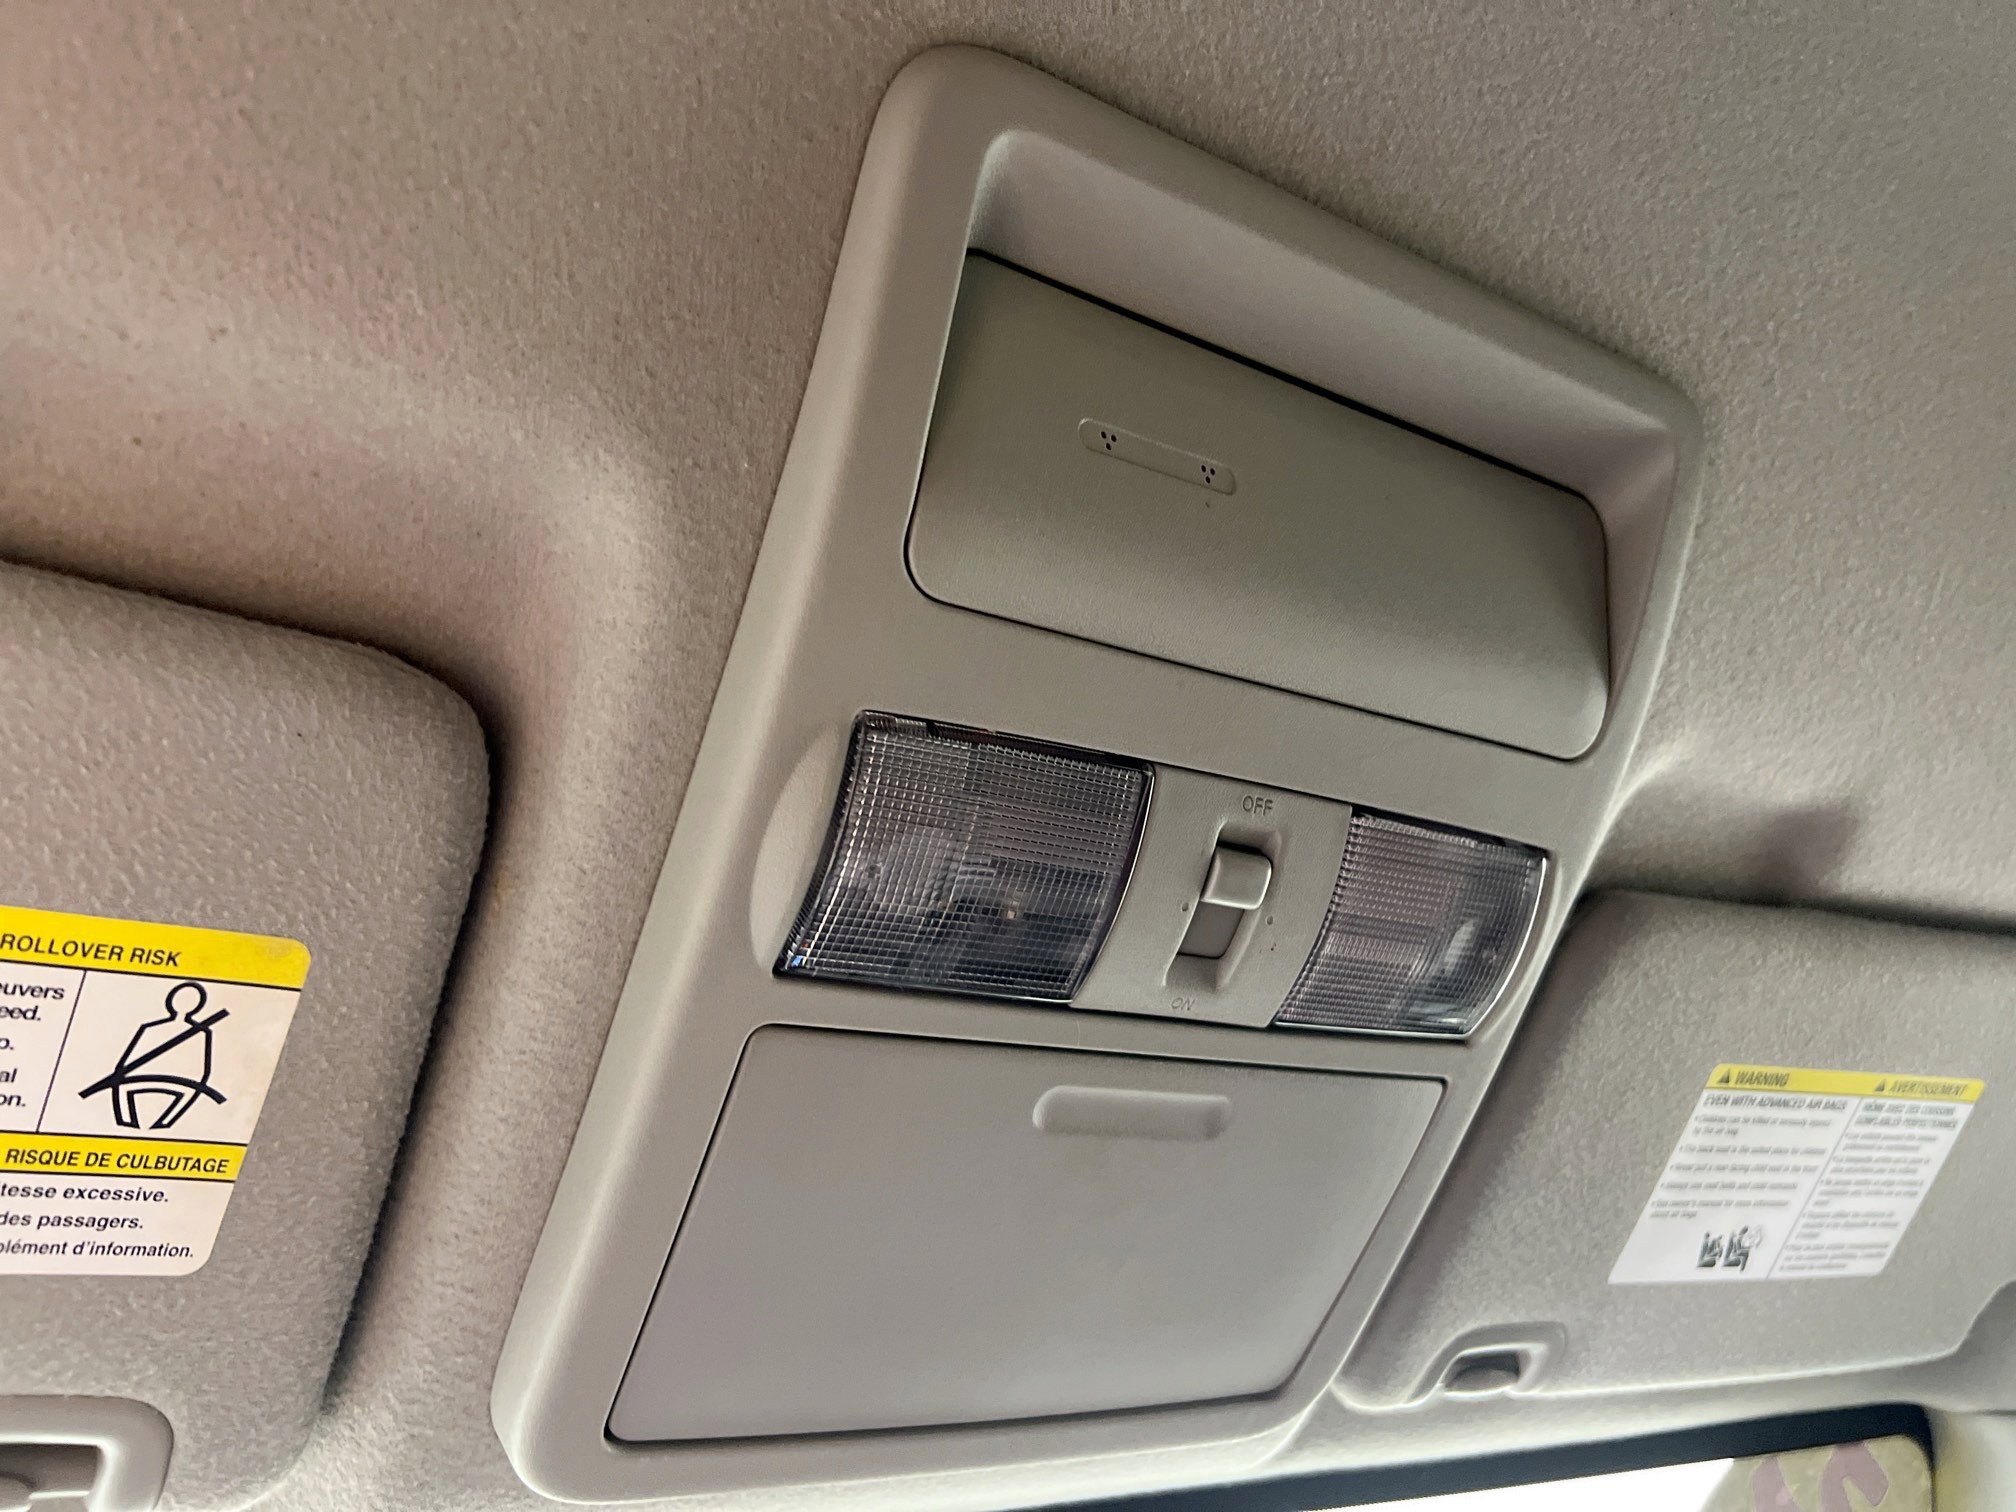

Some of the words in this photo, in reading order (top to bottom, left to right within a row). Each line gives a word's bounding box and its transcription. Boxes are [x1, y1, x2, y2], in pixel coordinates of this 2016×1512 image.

[1242, 795, 1274, 816] OFF
[0, 933, 127, 962] ROLLOVER
[130, 946, 182, 967] RISK
[0, 982, 65, 1000] uvers
[1170, 997, 1196, 1012] ON
[1734, 1071, 1790, 1087] WARNING
[5, 1148, 80, 1167] RISQUE
[85, 1152, 112, 1169] DE
[116, 1153, 230, 1174] CULBUTAGE
[63, 1186, 169, 1203] excessive.
[37, 1213, 144, 1232] passagers.
[73, 1241, 194, 1258] d'information.
